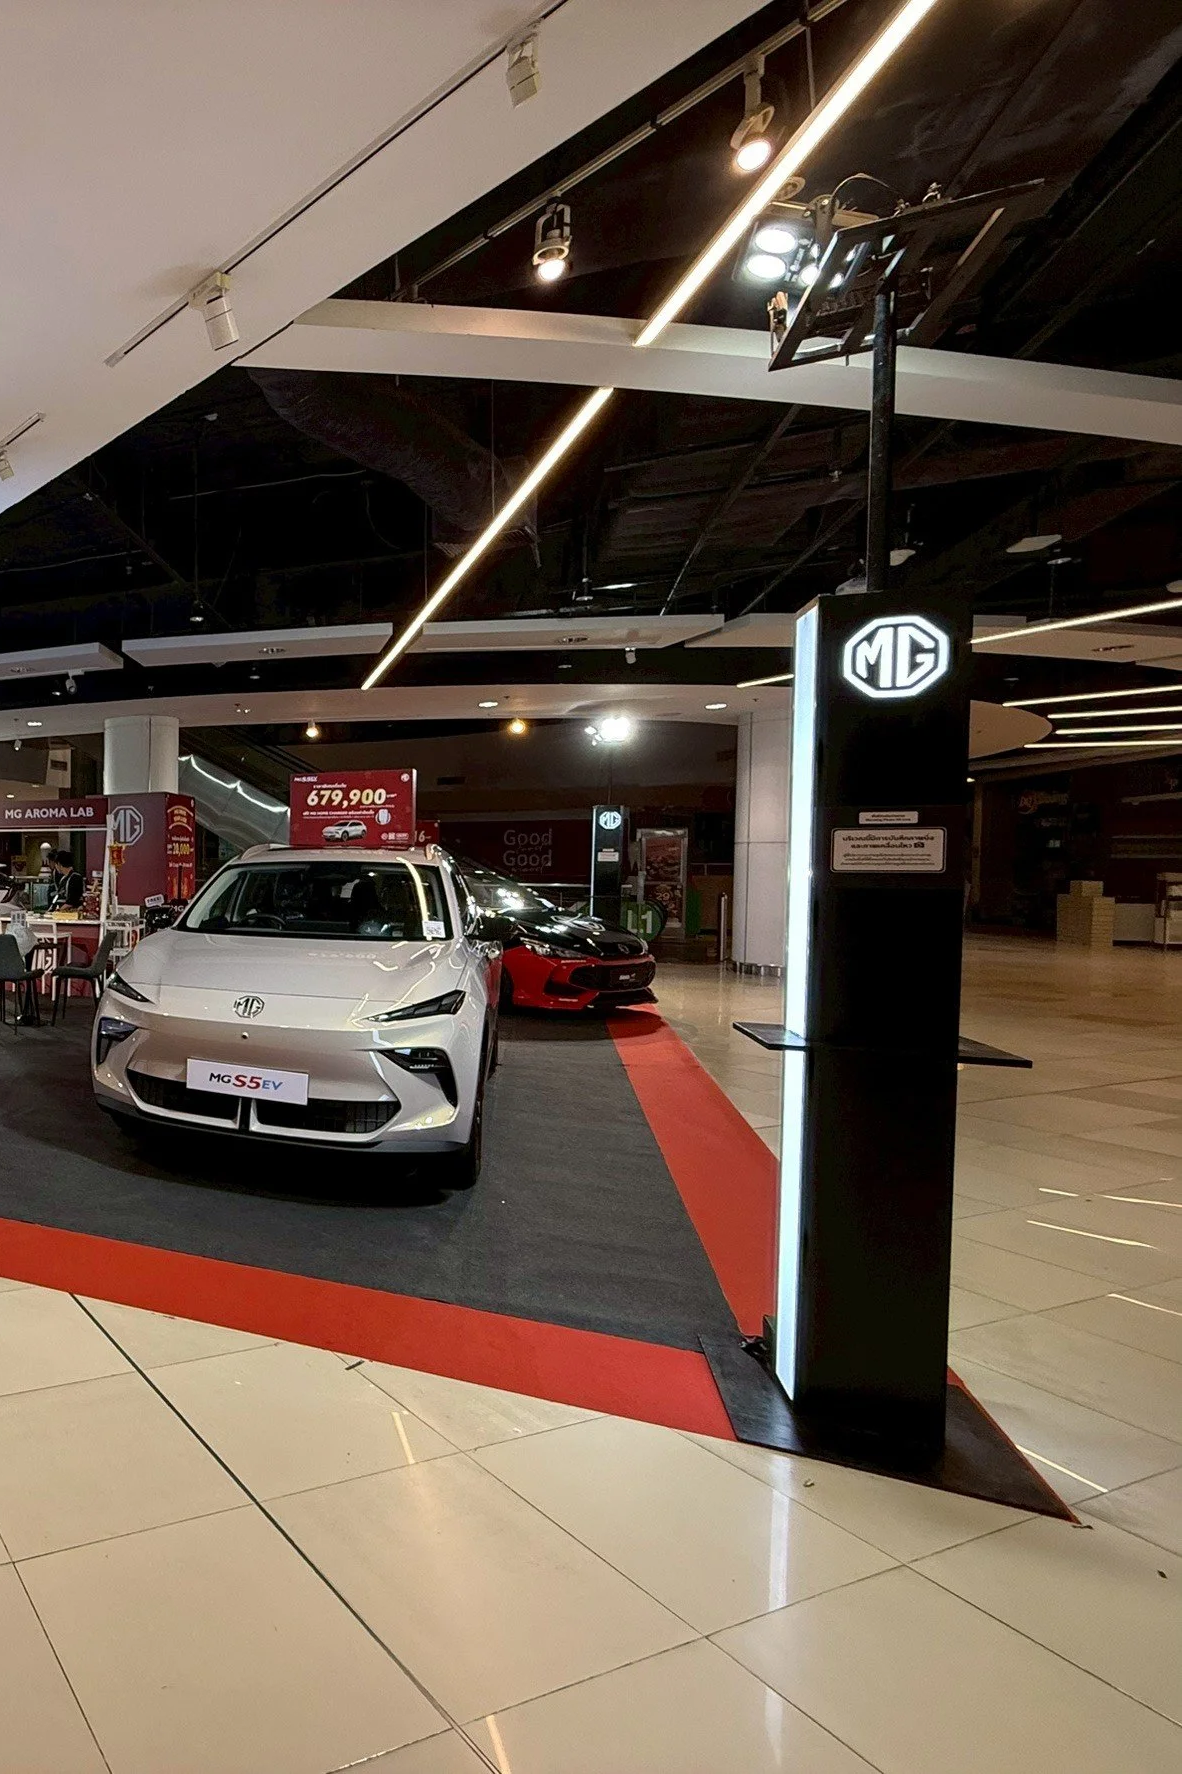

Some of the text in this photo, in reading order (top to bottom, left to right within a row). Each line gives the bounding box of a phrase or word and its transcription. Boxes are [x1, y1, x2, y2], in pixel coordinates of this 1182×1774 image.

[849, 621, 942, 693] MG
[307, 788, 387, 809] 679,900
[5, 806, 94, 819] MG AROMA LAB
[600, 812, 621, 829] MG
[503, 828, 553, 846] Good
[502, 849, 553, 867] Good
[234, 995, 264, 1018] MG
